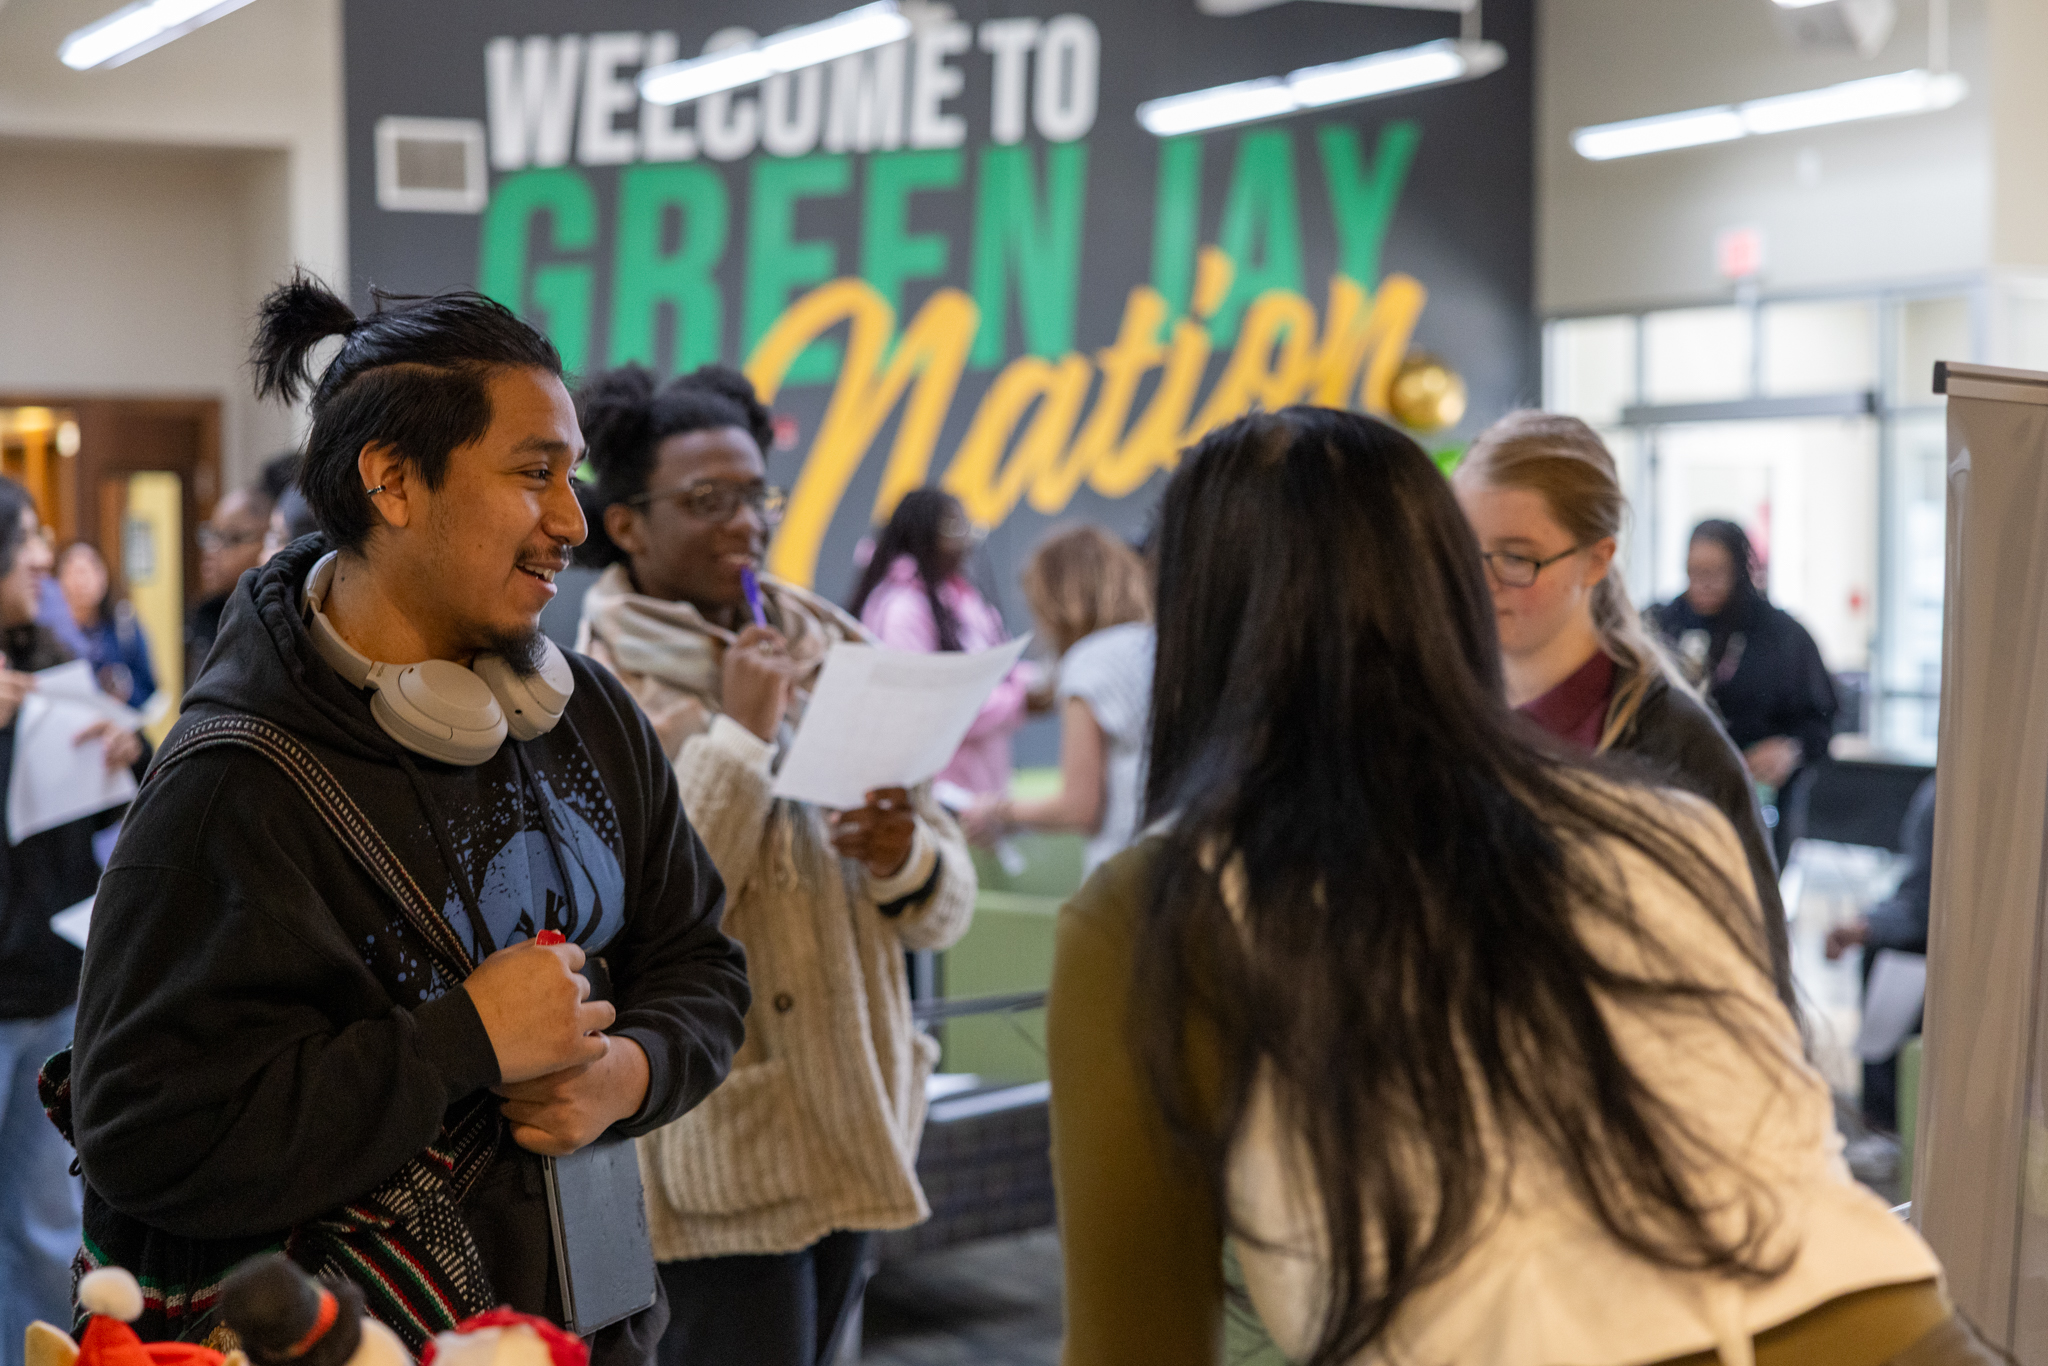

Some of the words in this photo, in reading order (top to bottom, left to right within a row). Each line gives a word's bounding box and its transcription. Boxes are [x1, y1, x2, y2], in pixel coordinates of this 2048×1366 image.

[486, 21, 971, 169] WELCOME
[979, 15, 1099, 144] TO
[480, 142, 1089, 386] GREEN
[742, 244, 1427, 588] Nation
